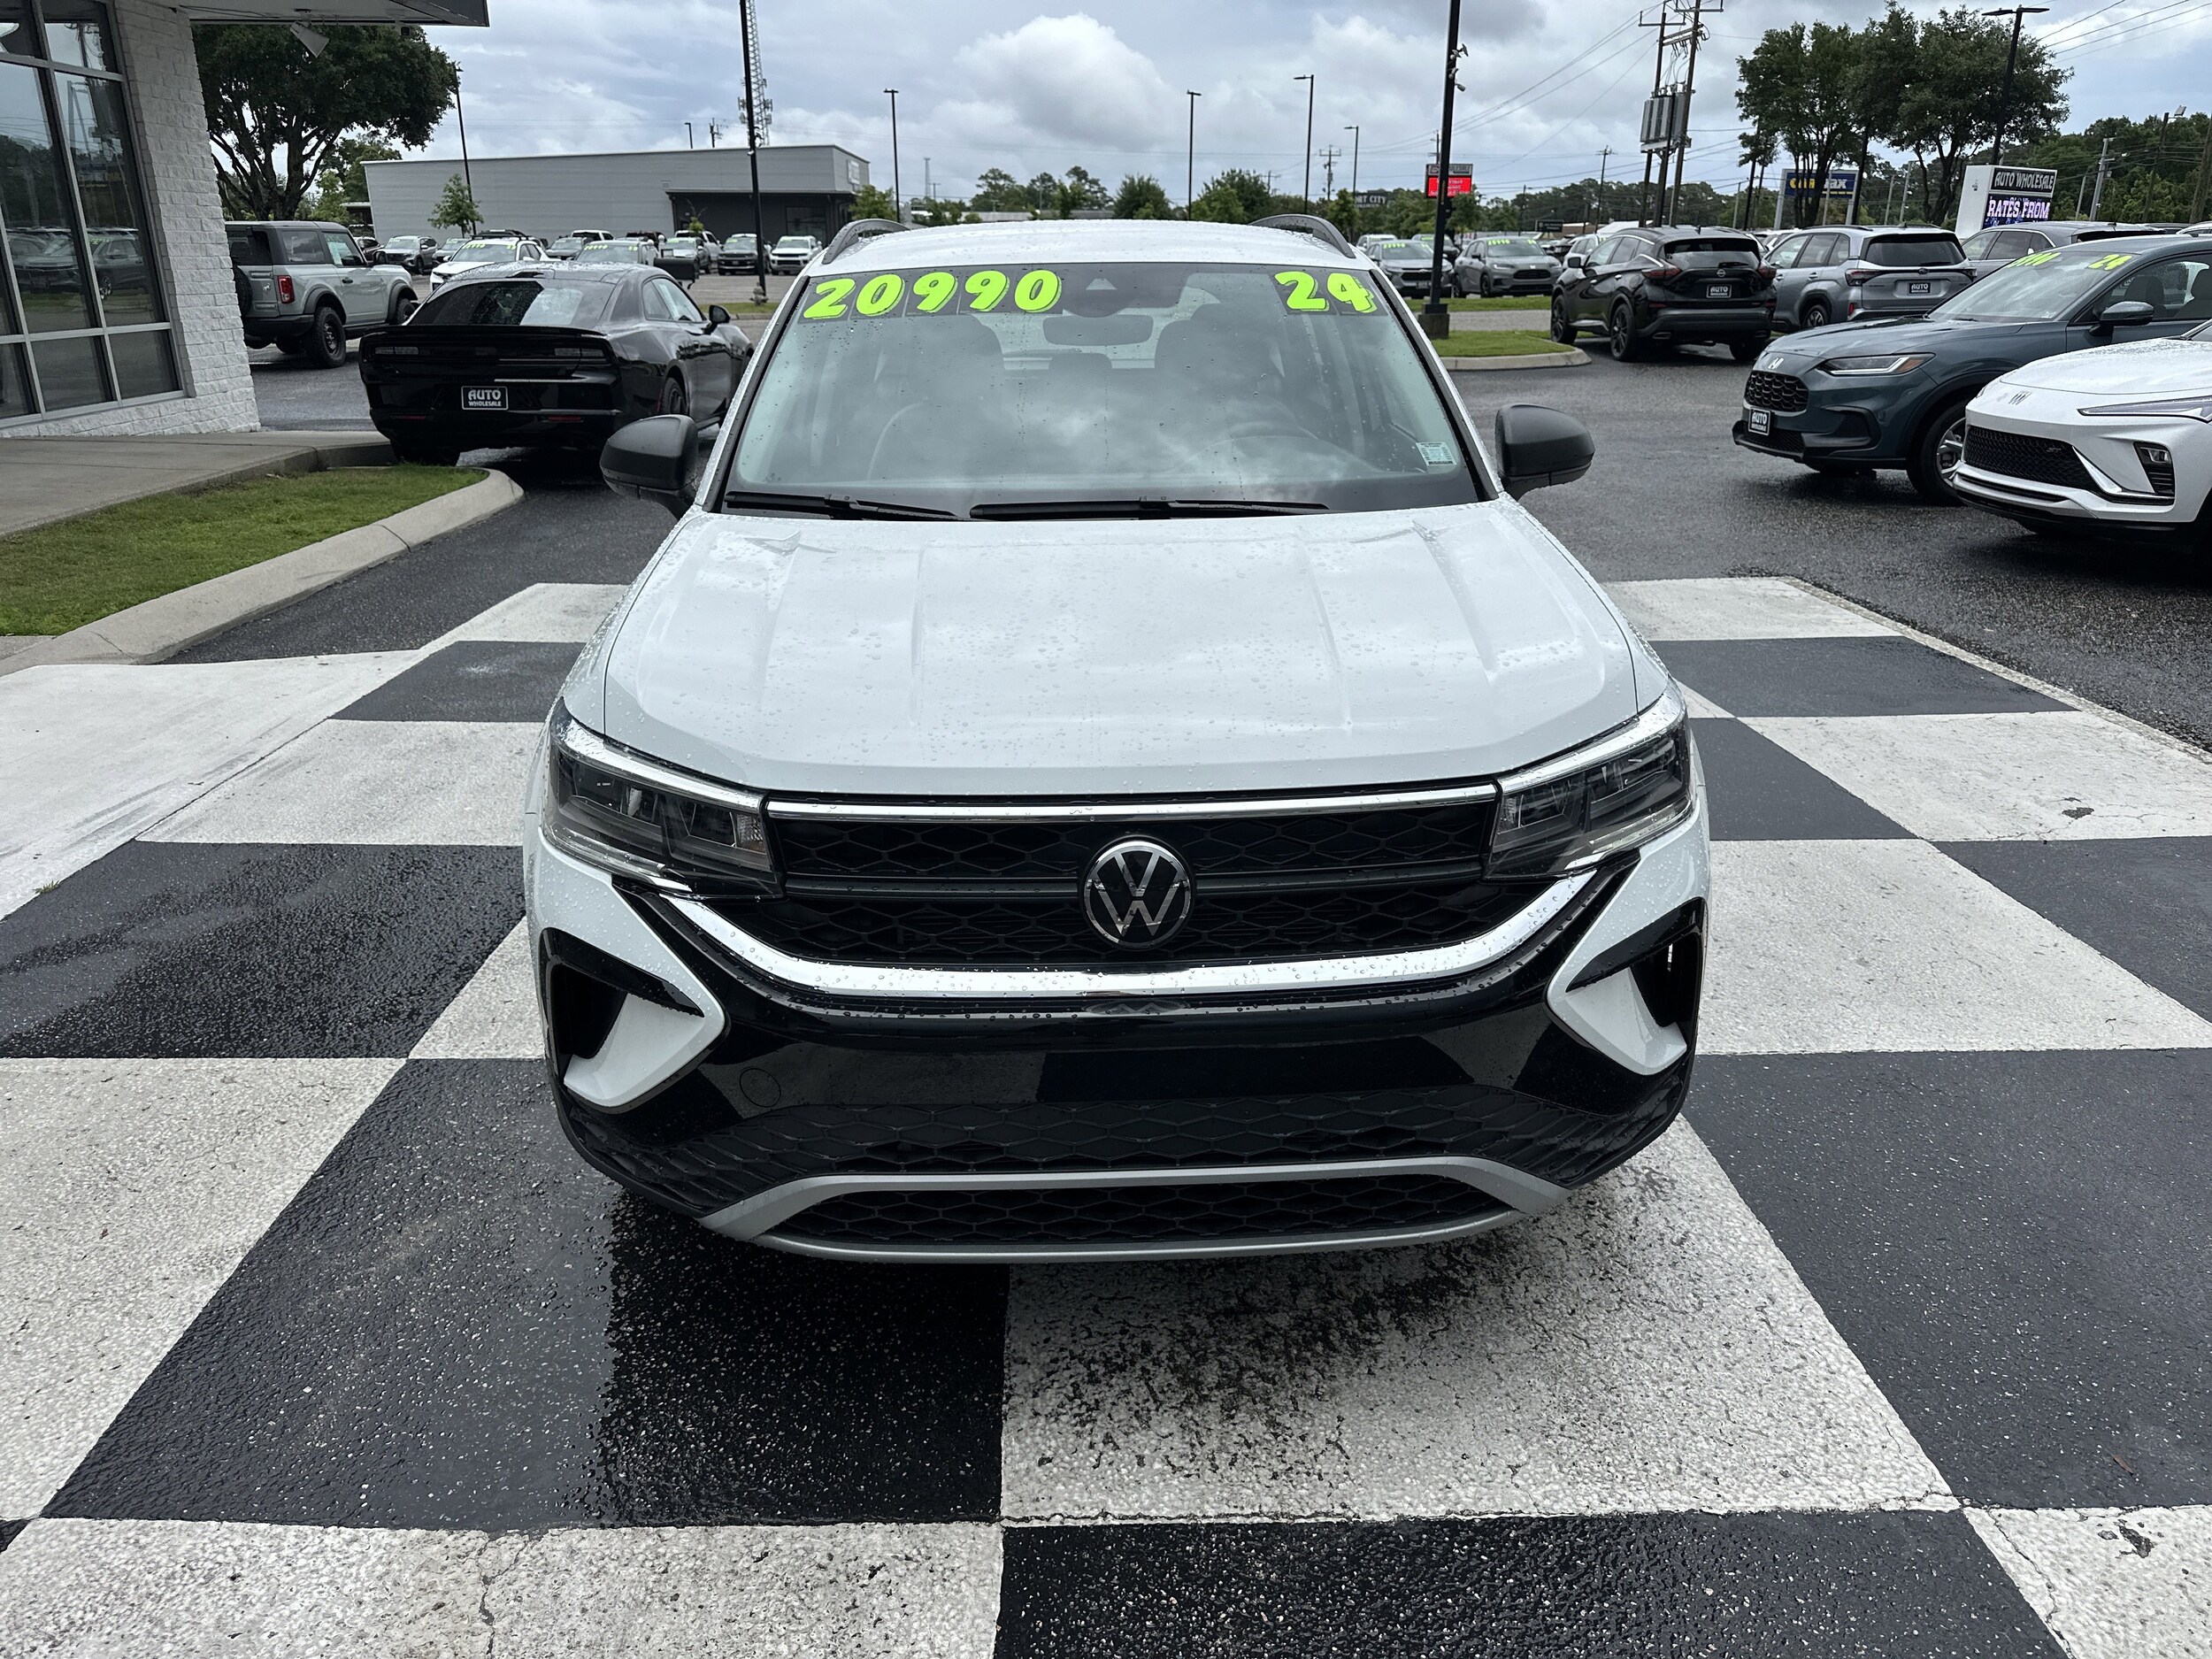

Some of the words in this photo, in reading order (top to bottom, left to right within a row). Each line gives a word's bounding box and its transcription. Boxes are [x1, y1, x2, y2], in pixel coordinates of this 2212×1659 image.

[1994, 171, 2016, 188] AUTO
[2016, 173, 2055, 190] WHOLESALE
[1987, 199, 2020, 218] RATES
[2021, 201, 2051, 219] FROM
[2088, 254, 2132, 271] 24
[803, 269, 1062, 319] 20990
[1275, 271, 1377, 313] 24
[468, 389, 502, 401] AUTO
[1752, 411, 1768, 425] AUTO
